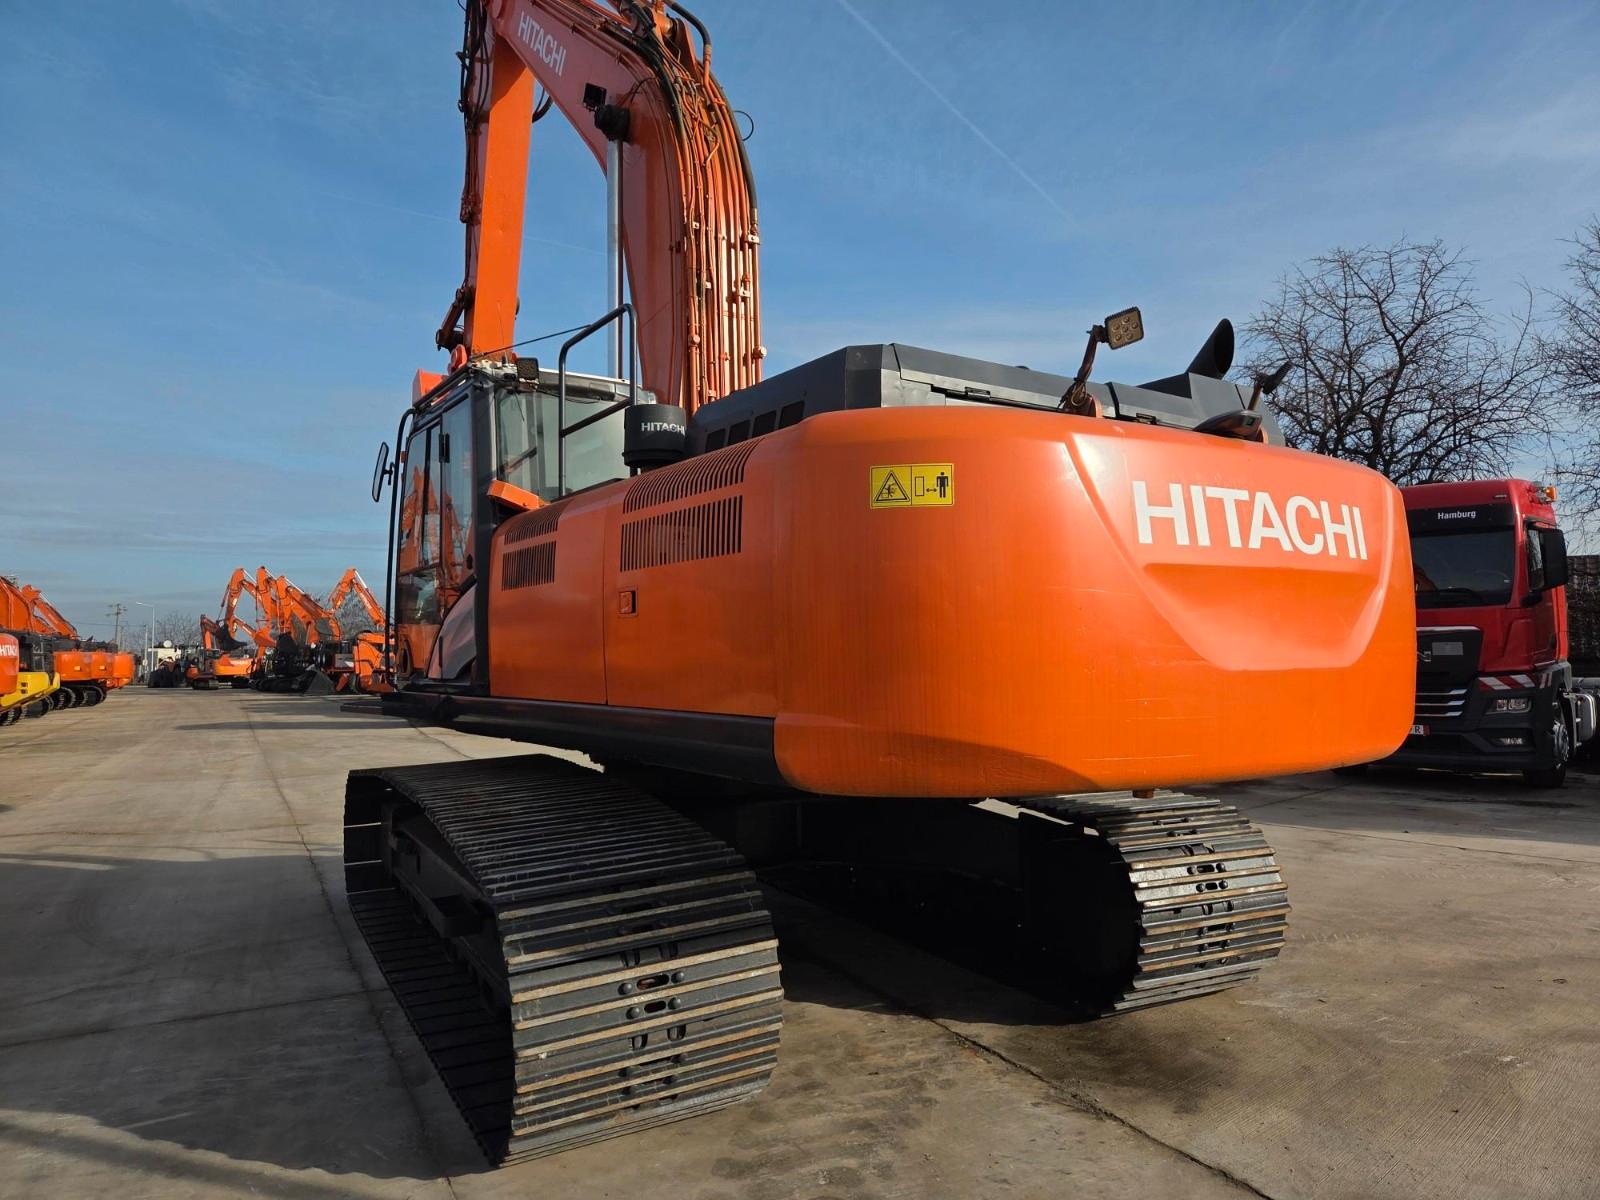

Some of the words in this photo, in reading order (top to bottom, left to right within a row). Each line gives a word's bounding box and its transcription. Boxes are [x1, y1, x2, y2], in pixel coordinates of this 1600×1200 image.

[518, 11, 566, 77] HITACHI
[641, 422, 686, 436] HITACHI
[1132, 480, 1368, 560] HITACHI
[1437, 510, 1476, 520] Hamburg
